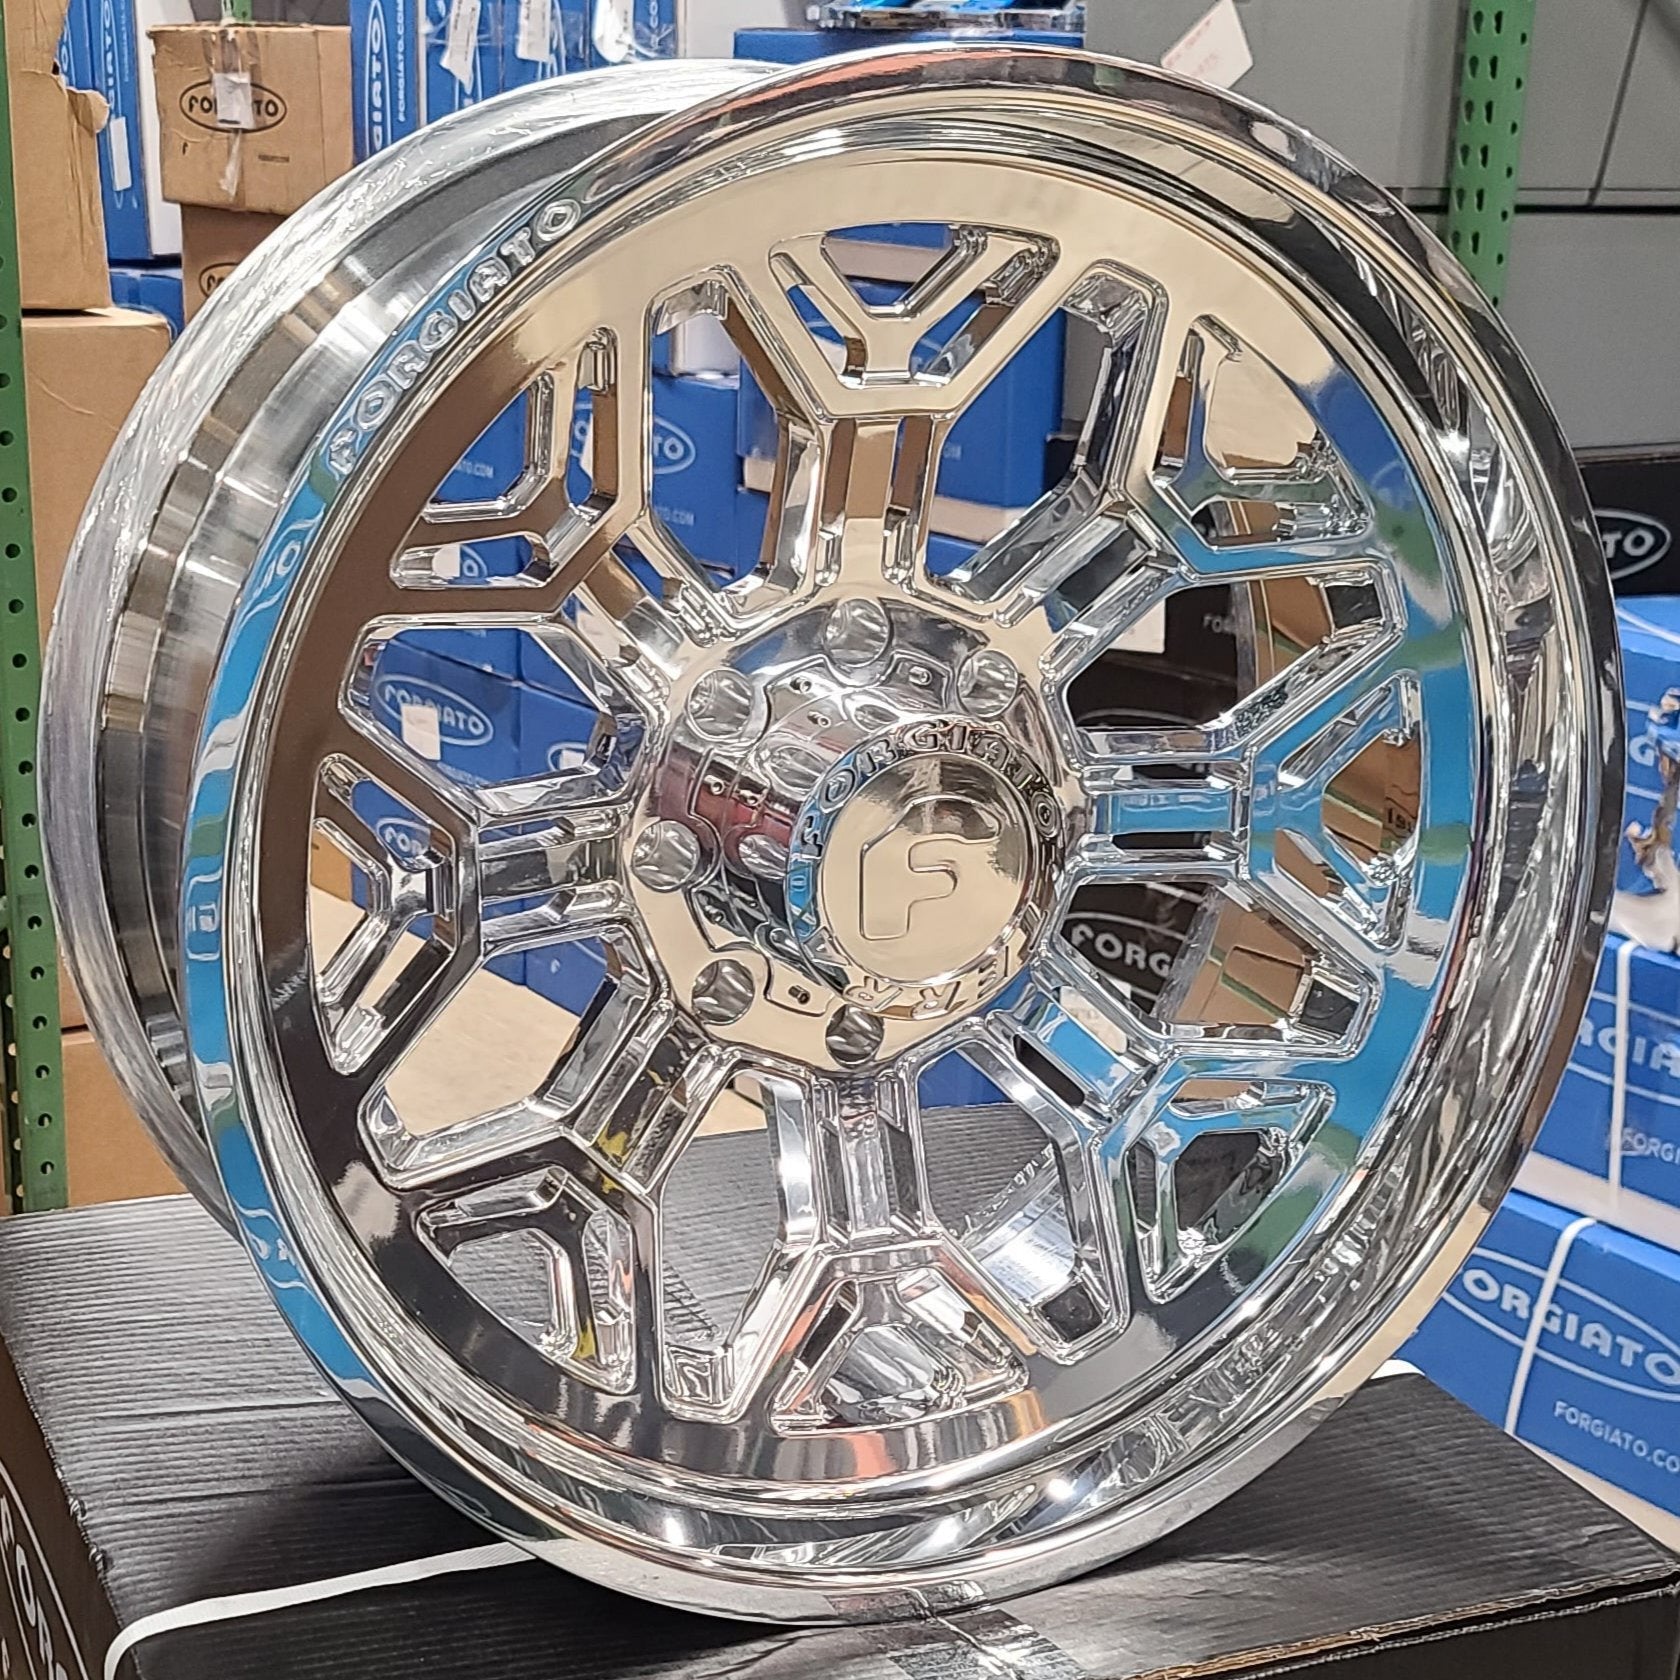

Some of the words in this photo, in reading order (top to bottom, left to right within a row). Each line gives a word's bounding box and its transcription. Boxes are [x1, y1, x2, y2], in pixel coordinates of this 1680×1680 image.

[188, 95, 279, 117] FOTO
[327, 198, 582, 476] FORGIATO
[1602, 528, 1655, 558] TO
[801, 721, 1058, 860] FORGIATO
